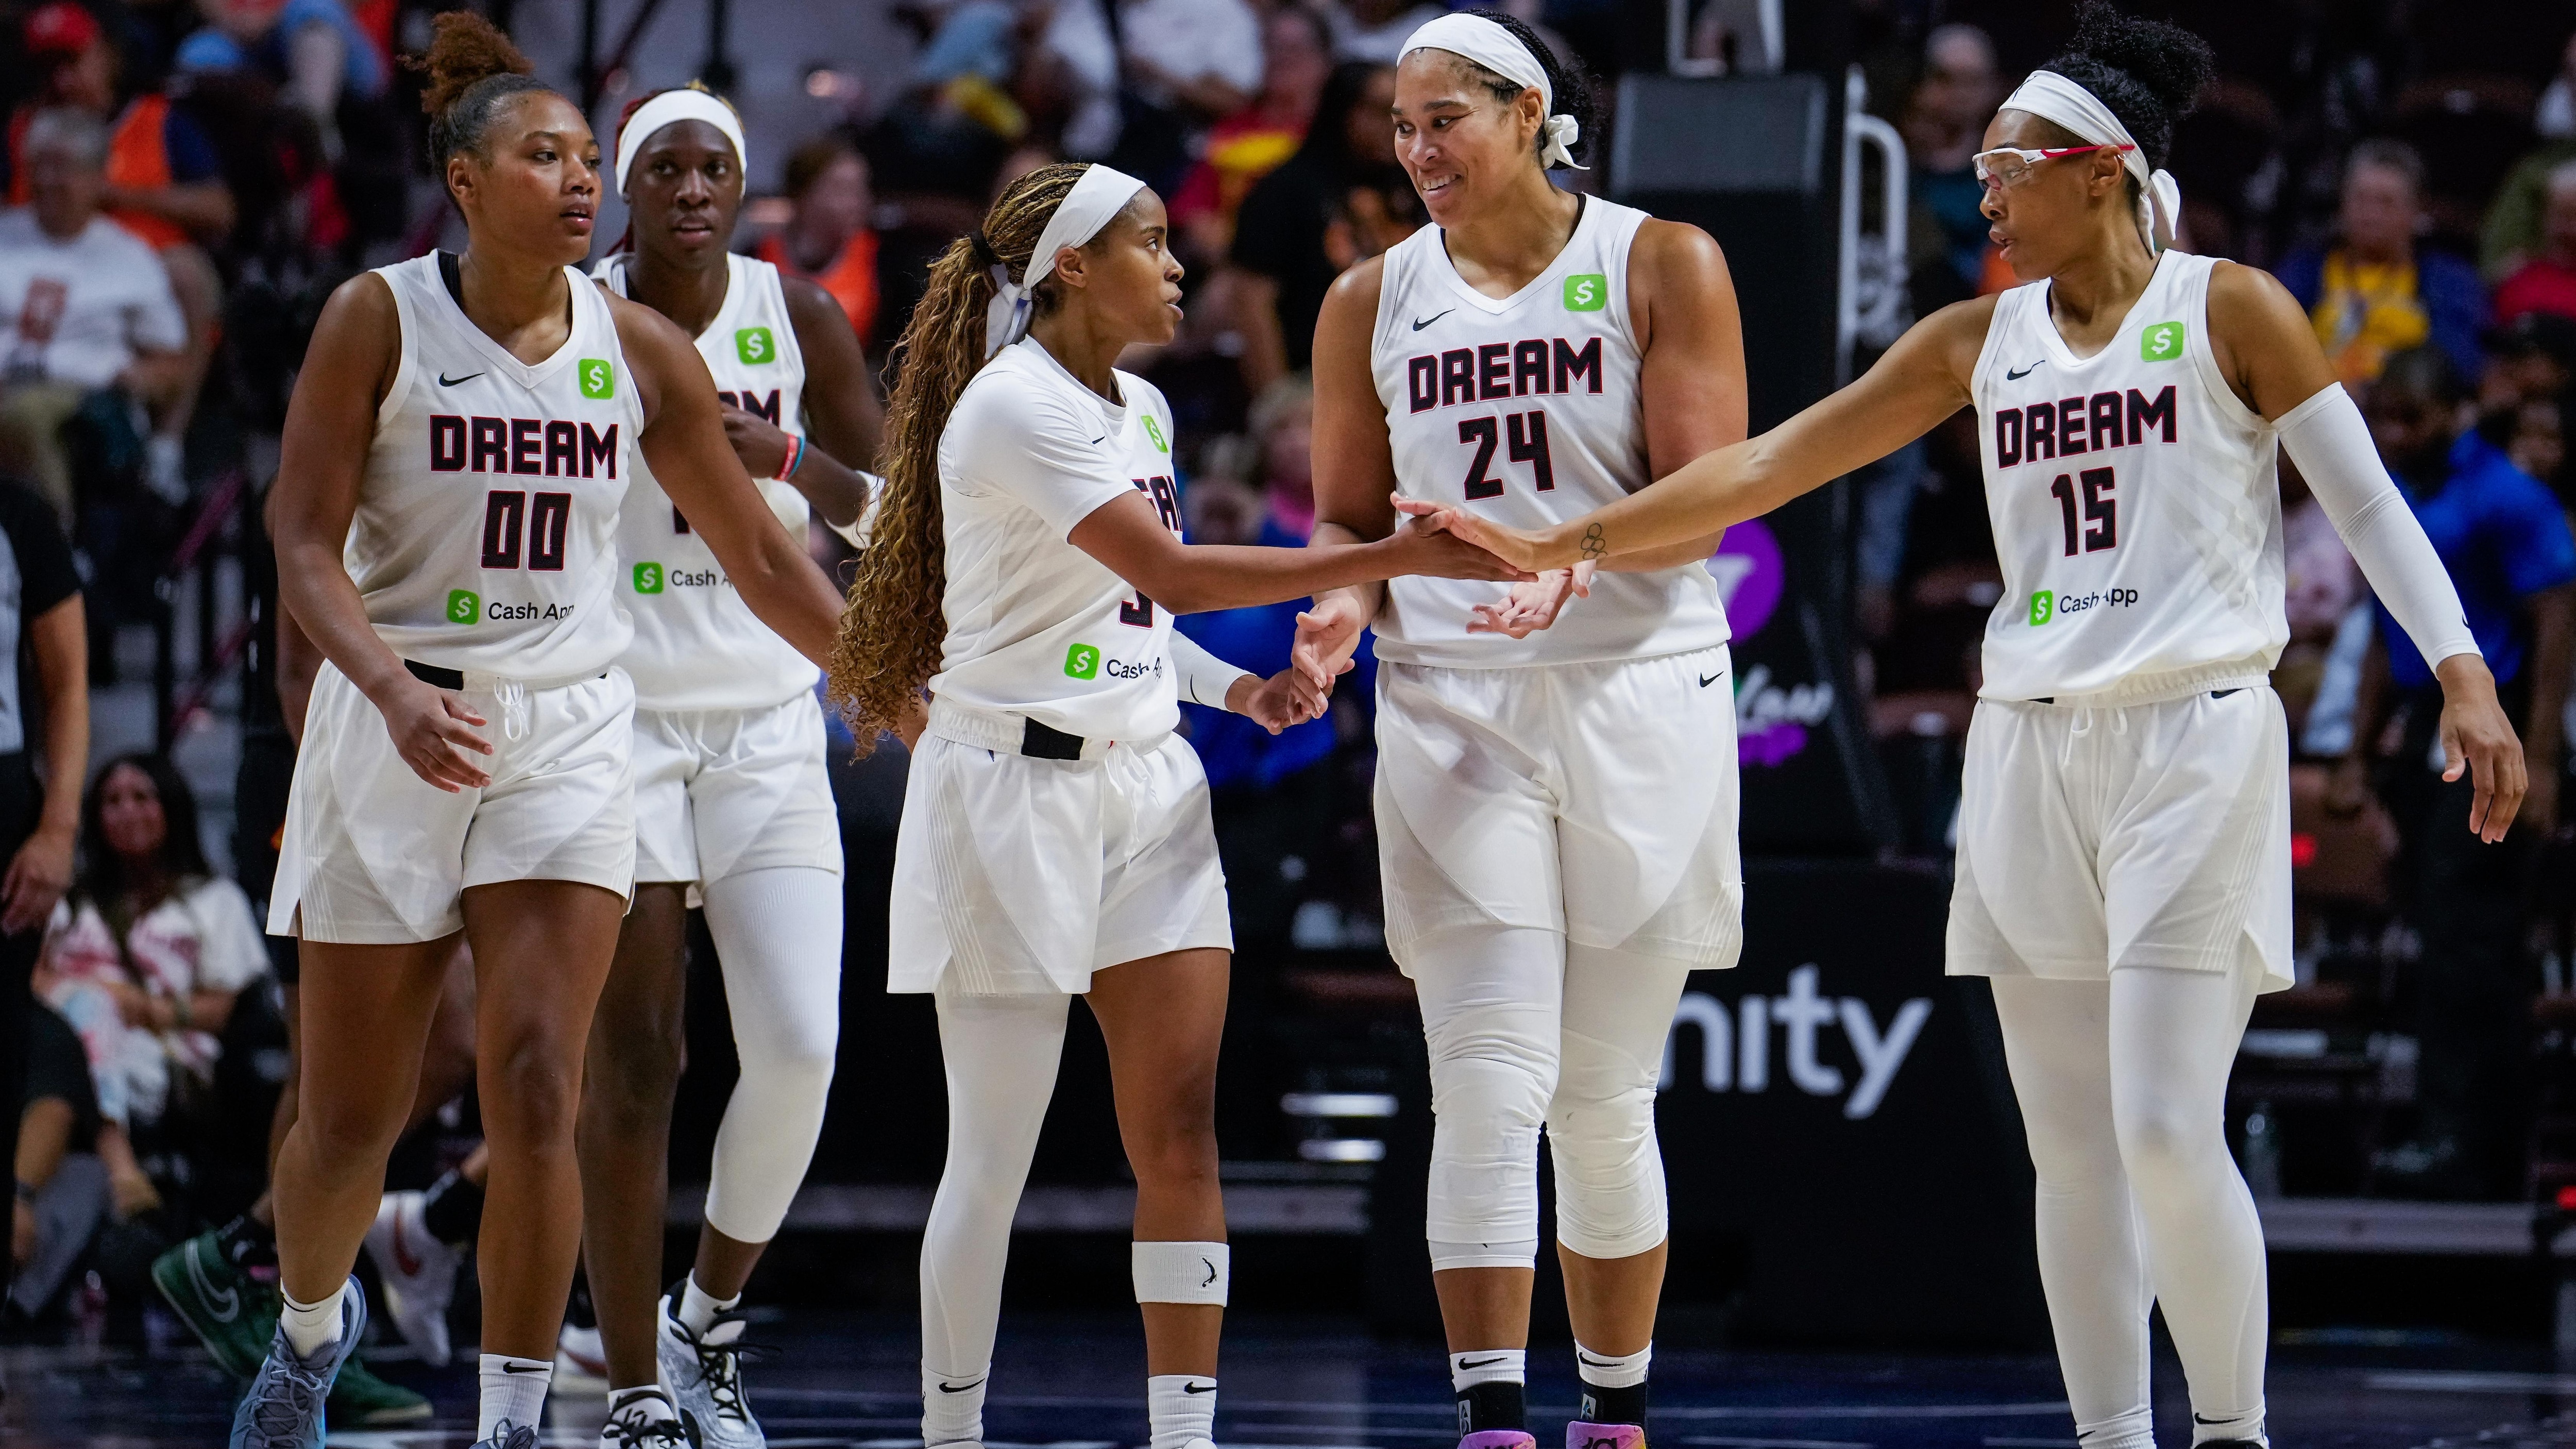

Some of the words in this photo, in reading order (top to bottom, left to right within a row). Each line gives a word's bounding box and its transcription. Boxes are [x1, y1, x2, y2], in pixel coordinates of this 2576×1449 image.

[1409, 338, 1603, 414] DREAM
[430, 414, 618, 479] DREAM
[1458, 410, 1555, 501] 24
[1996, 385, 2177, 469] DREAM
[481, 490, 572, 571] 00
[2050, 466, 2116, 557] 15
[488, 602, 538, 620] Cash
[671, 569, 717, 586] Cash
[2060, 592, 2099, 614] Cash
[1107, 659, 1149, 679] Cash
[1656, 963, 1933, 1119] nity
